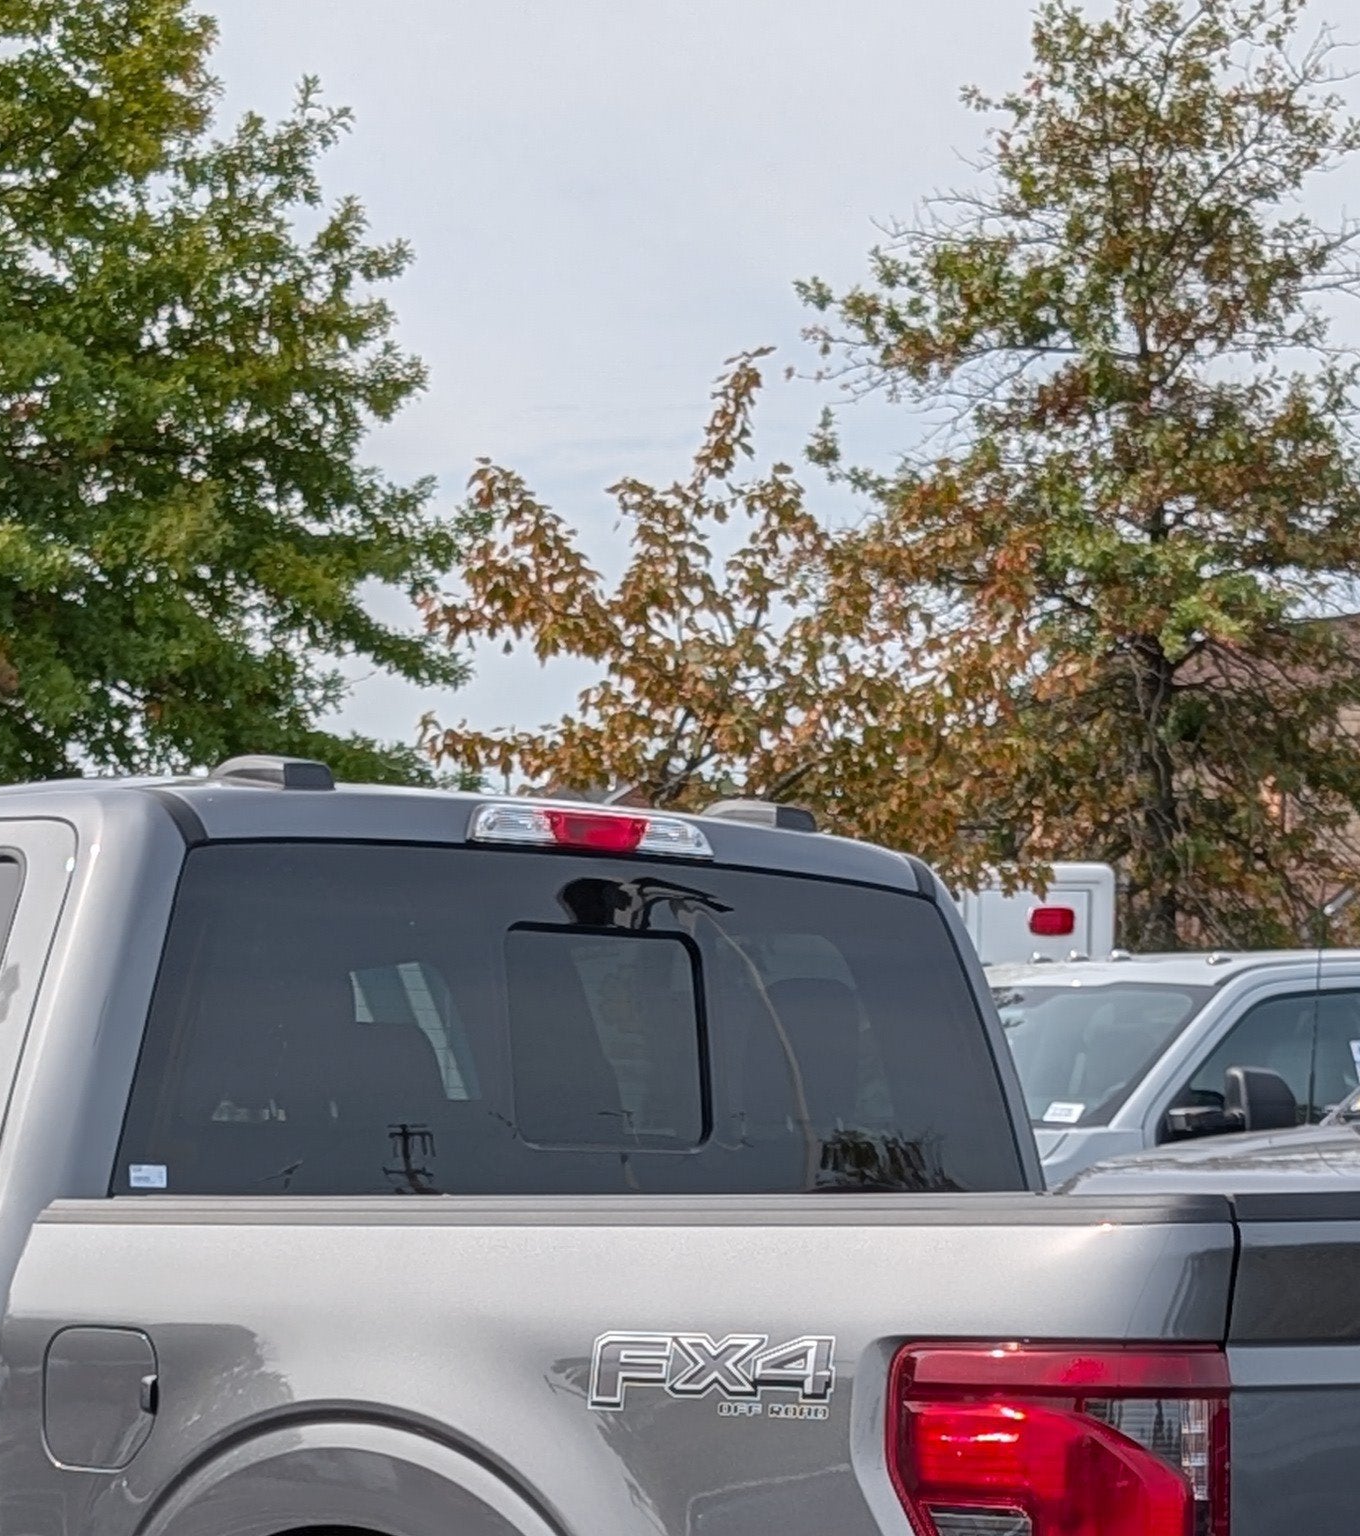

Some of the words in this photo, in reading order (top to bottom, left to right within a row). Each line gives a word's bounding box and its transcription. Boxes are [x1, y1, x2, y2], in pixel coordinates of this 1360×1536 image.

[588, 1331, 836, 1411] FX4
[717, 1402, 762, 1417] OFF
[768, 1403, 829, 1420] ROAD
